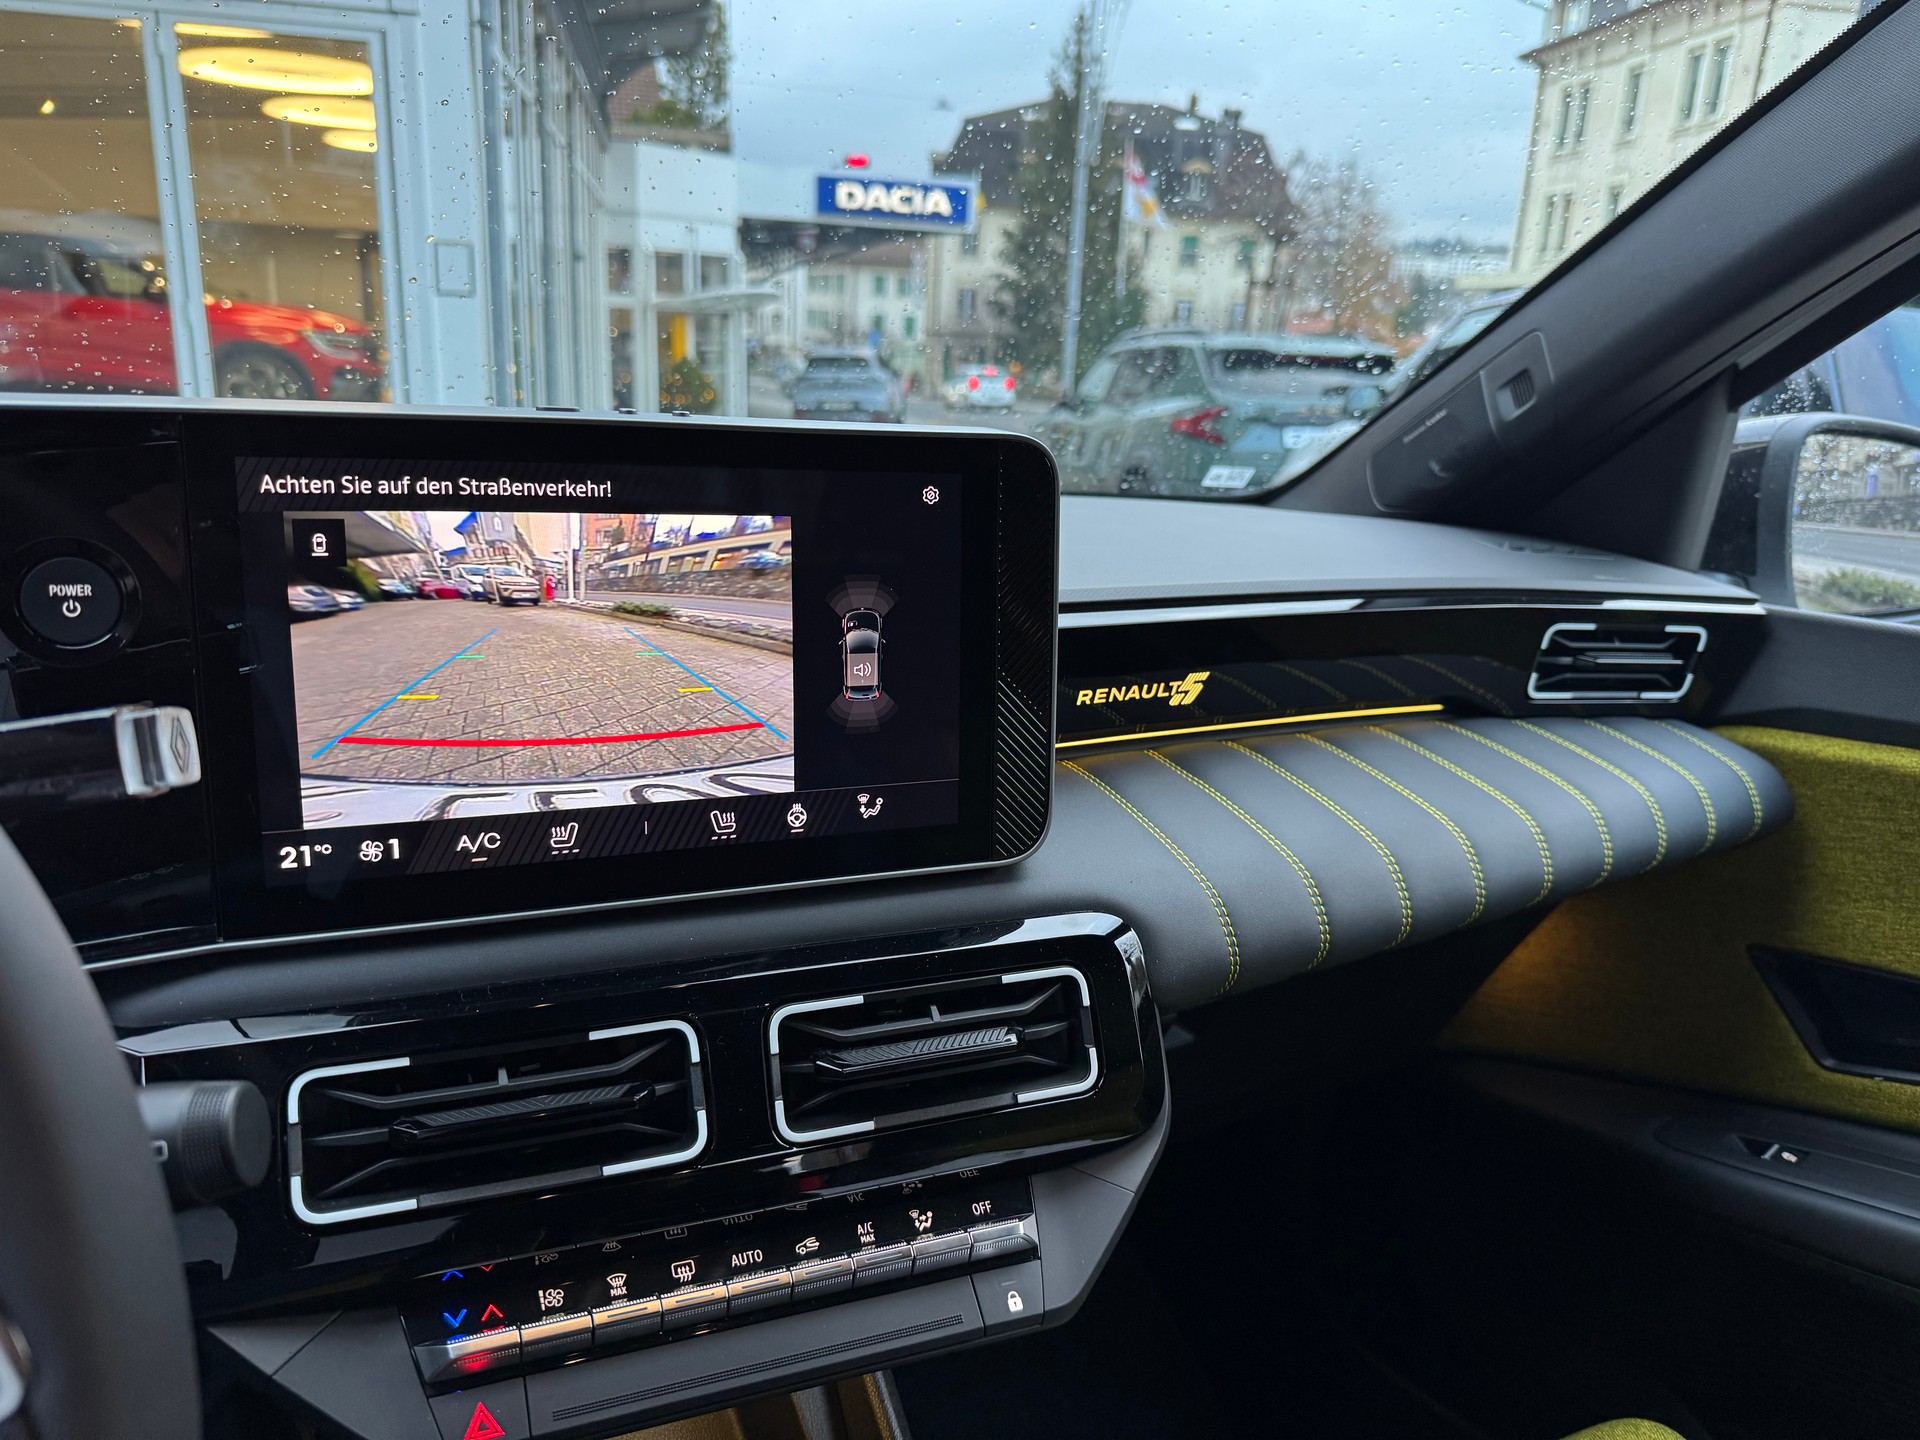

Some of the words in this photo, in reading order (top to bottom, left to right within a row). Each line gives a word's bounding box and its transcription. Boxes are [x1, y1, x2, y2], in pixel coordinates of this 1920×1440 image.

[834, 180, 953, 217] DACIA
[259, 474, 335, 495] Achten
[341, 476, 373, 495] Sie
[378, 476, 410, 495] auf
[416, 477, 453, 496] den
[458, 477, 613, 498] Straßenverkehr!
[49, 584, 92, 597] POWER
[1076, 681, 1183, 706] RENAULT
[388, 838, 400, 861] 1
[456, 832, 502, 852] A/C
[972, 1200, 992, 1215] OFF
[857, 1221, 875, 1235] A/C
[860, 1234, 876, 1243] MAX
[731, 1250, 763, 1267] AUTO
[610, 1286, 628, 1297] MAX
